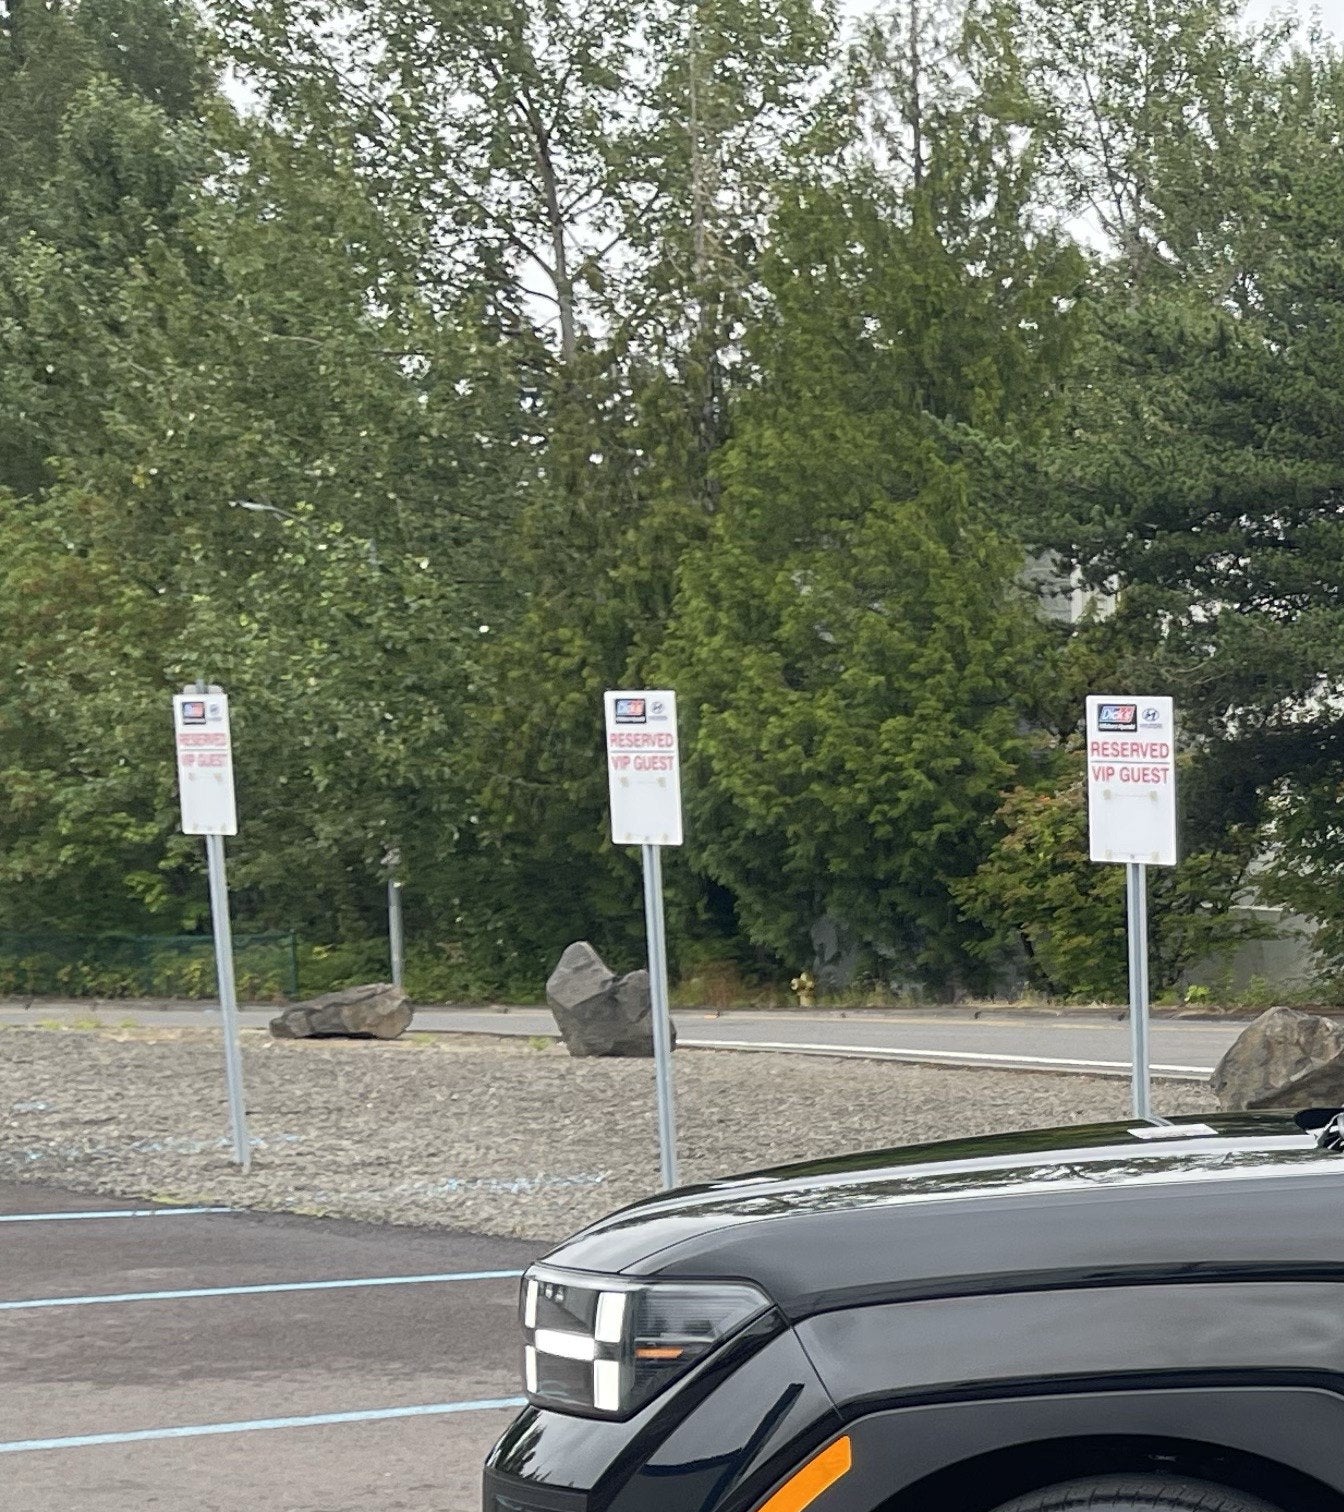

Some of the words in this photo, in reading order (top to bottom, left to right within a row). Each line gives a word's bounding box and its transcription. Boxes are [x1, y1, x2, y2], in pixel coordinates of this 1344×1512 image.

[609, 733, 674, 748] RESERVED
[1090, 741, 1169, 759] RESERVED
[611, 756, 631, 770] VIP
[634, 755, 674, 771] GUEST
[1092, 766, 1115, 783] VIP
[1119, 766, 1169, 784] GUEST
